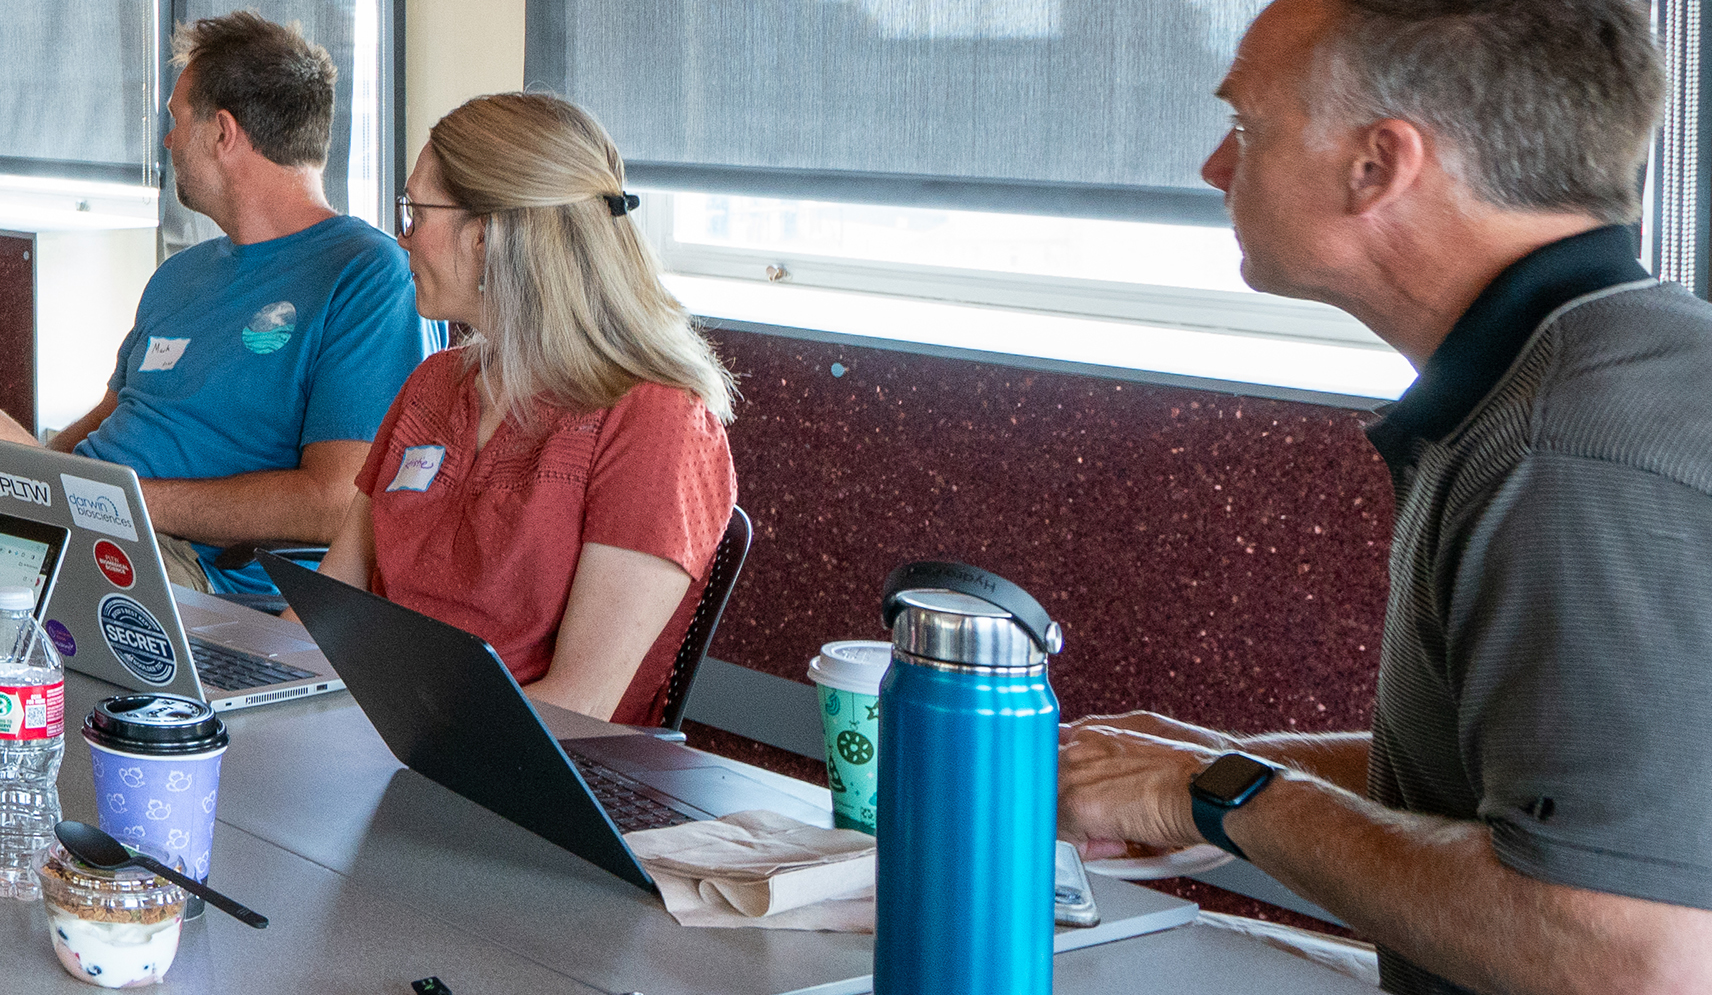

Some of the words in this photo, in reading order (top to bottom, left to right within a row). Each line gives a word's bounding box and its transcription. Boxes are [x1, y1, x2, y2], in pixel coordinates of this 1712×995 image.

[68, 493, 108, 513] darwin
[77, 505, 132, 528] biosciences
[105, 624, 168, 657] SECRET
